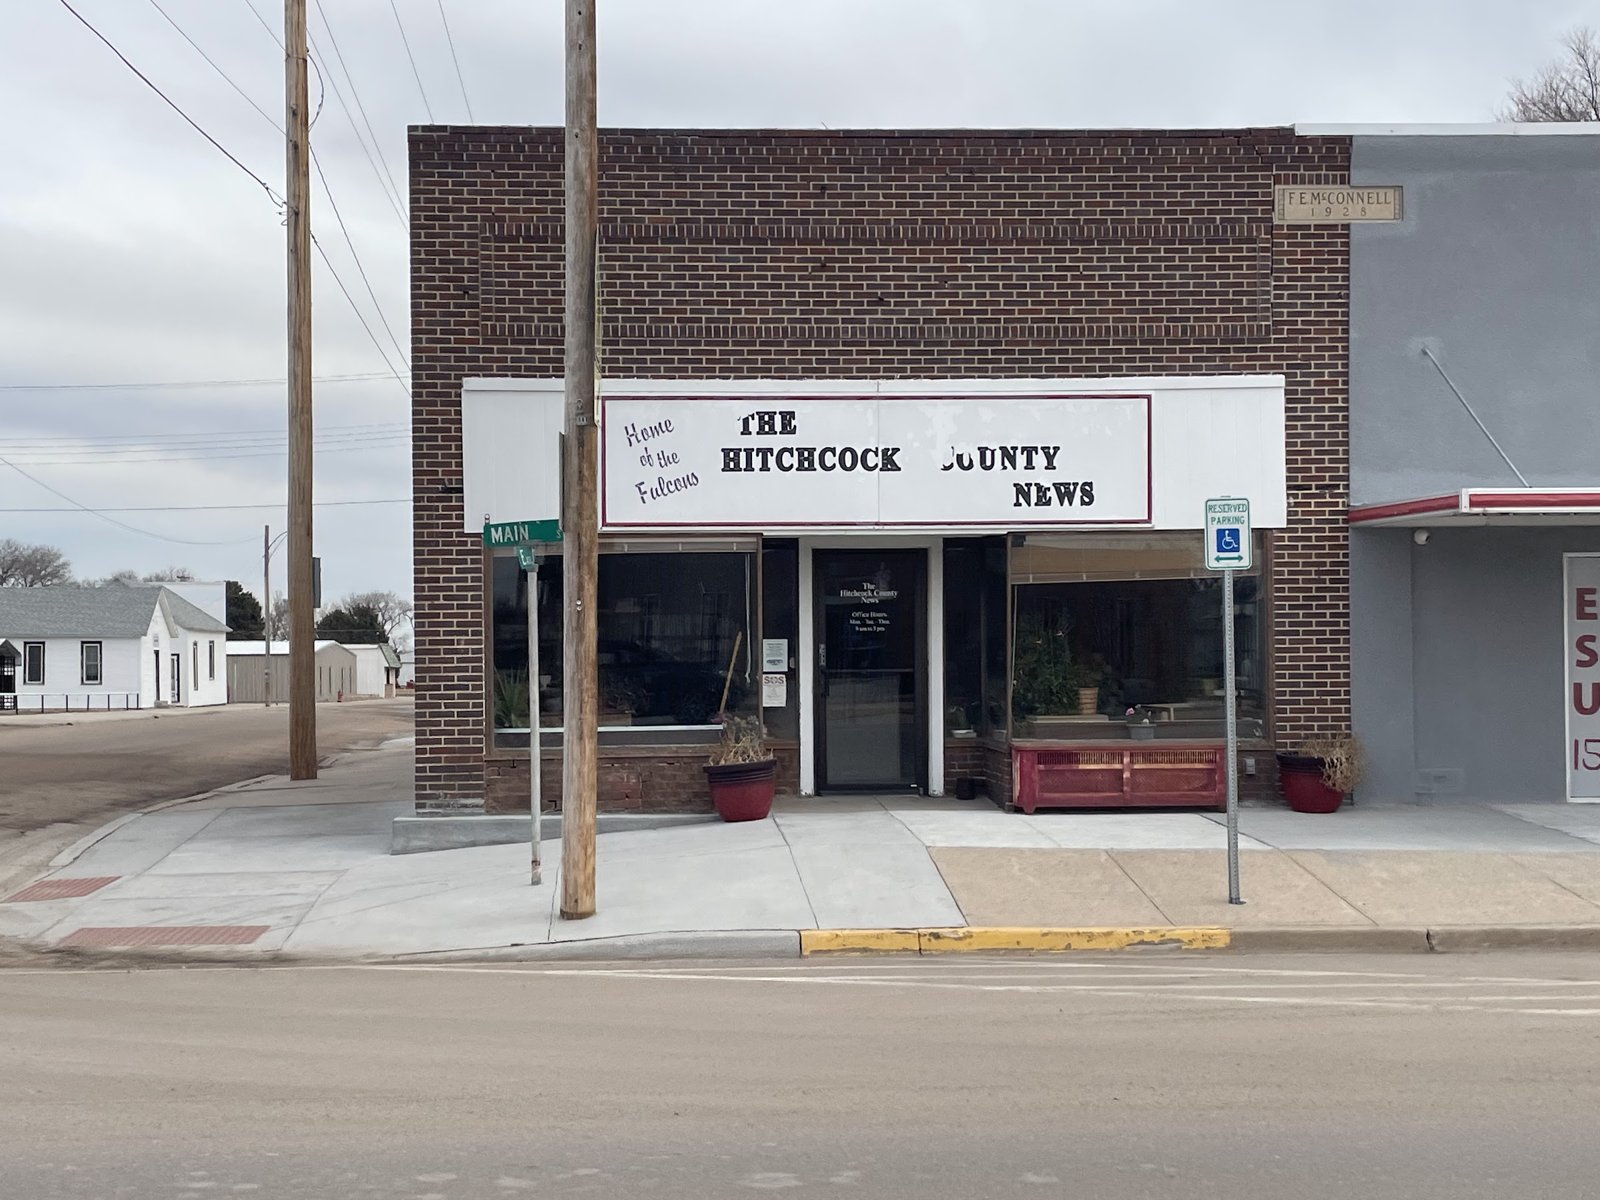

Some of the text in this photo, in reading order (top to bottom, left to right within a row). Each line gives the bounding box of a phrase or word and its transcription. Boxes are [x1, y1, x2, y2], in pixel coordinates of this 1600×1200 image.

[624, 418, 675, 447] Home
[737, 410, 797, 436] THE
[656, 449, 681, 469] the
[721, 446, 902, 473] HITCHCOCK
[634, 471, 700, 505] Falcons
[1013, 480, 1095, 508] NEWS
[1208, 503, 1248, 514] RESERVED
[1210, 515, 1246, 526] PARKING
[490, 524, 530, 544] MAIN
